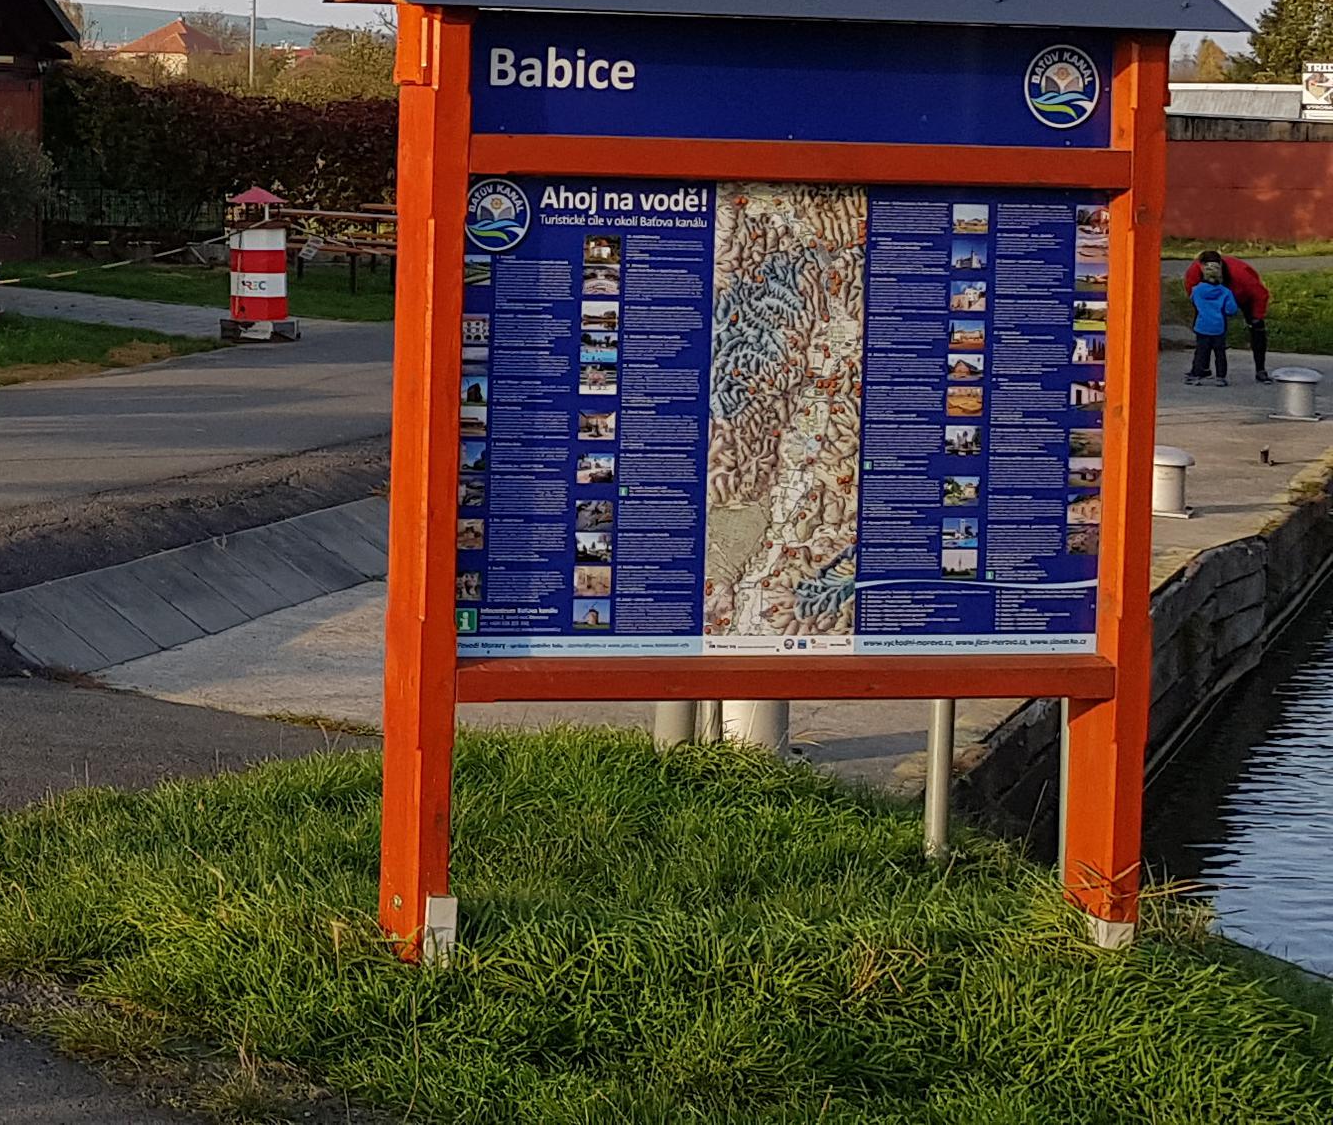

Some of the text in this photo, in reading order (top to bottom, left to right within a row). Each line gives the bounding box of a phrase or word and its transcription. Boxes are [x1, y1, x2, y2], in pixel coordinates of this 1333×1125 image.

[489, 46, 636, 91] Babice
[540, 185, 708, 215] Ahoj na vodě!
[540, 214, 708, 228] Turistické cíle v okolí Baťova kanálu
